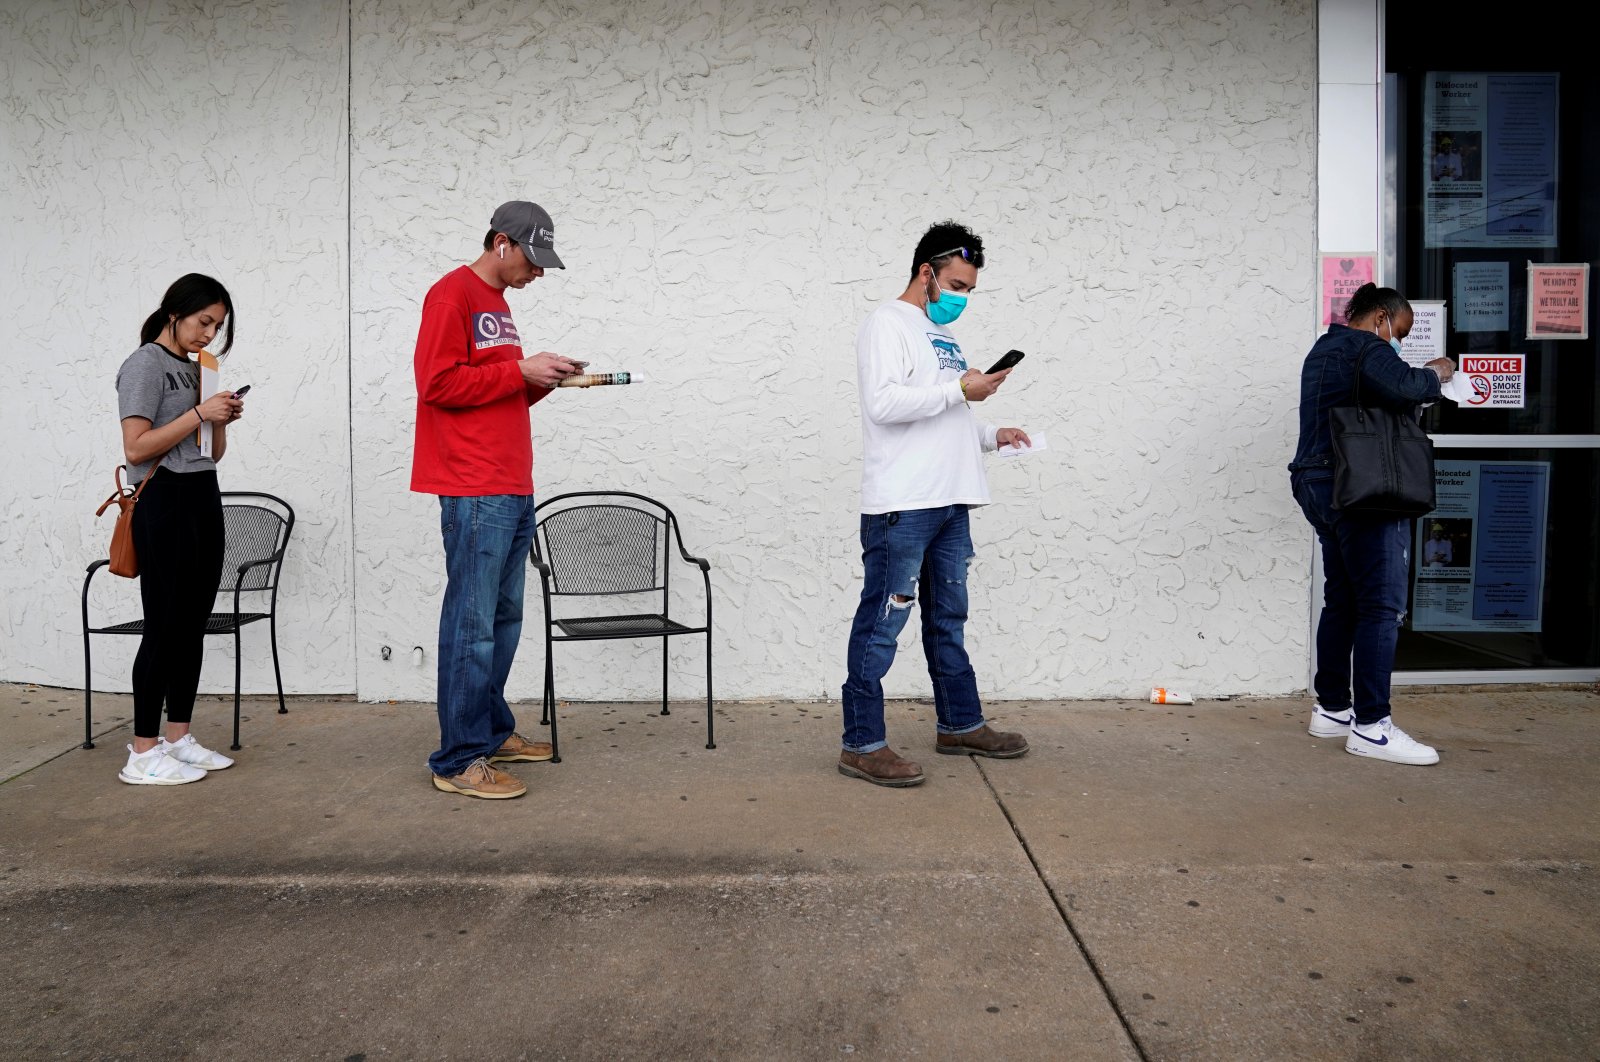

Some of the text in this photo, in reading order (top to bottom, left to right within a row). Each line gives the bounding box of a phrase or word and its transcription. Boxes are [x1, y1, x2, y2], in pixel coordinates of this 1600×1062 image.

[1435, 81, 1478, 89] Dislocated
[1441, 90, 1473, 98] Worker
[1543, 278, 1577, 287] WE KNOW IT'S
[1540, 297, 1579, 306] WE TRULY ARE
[1467, 359, 1517, 372] NOTICE
